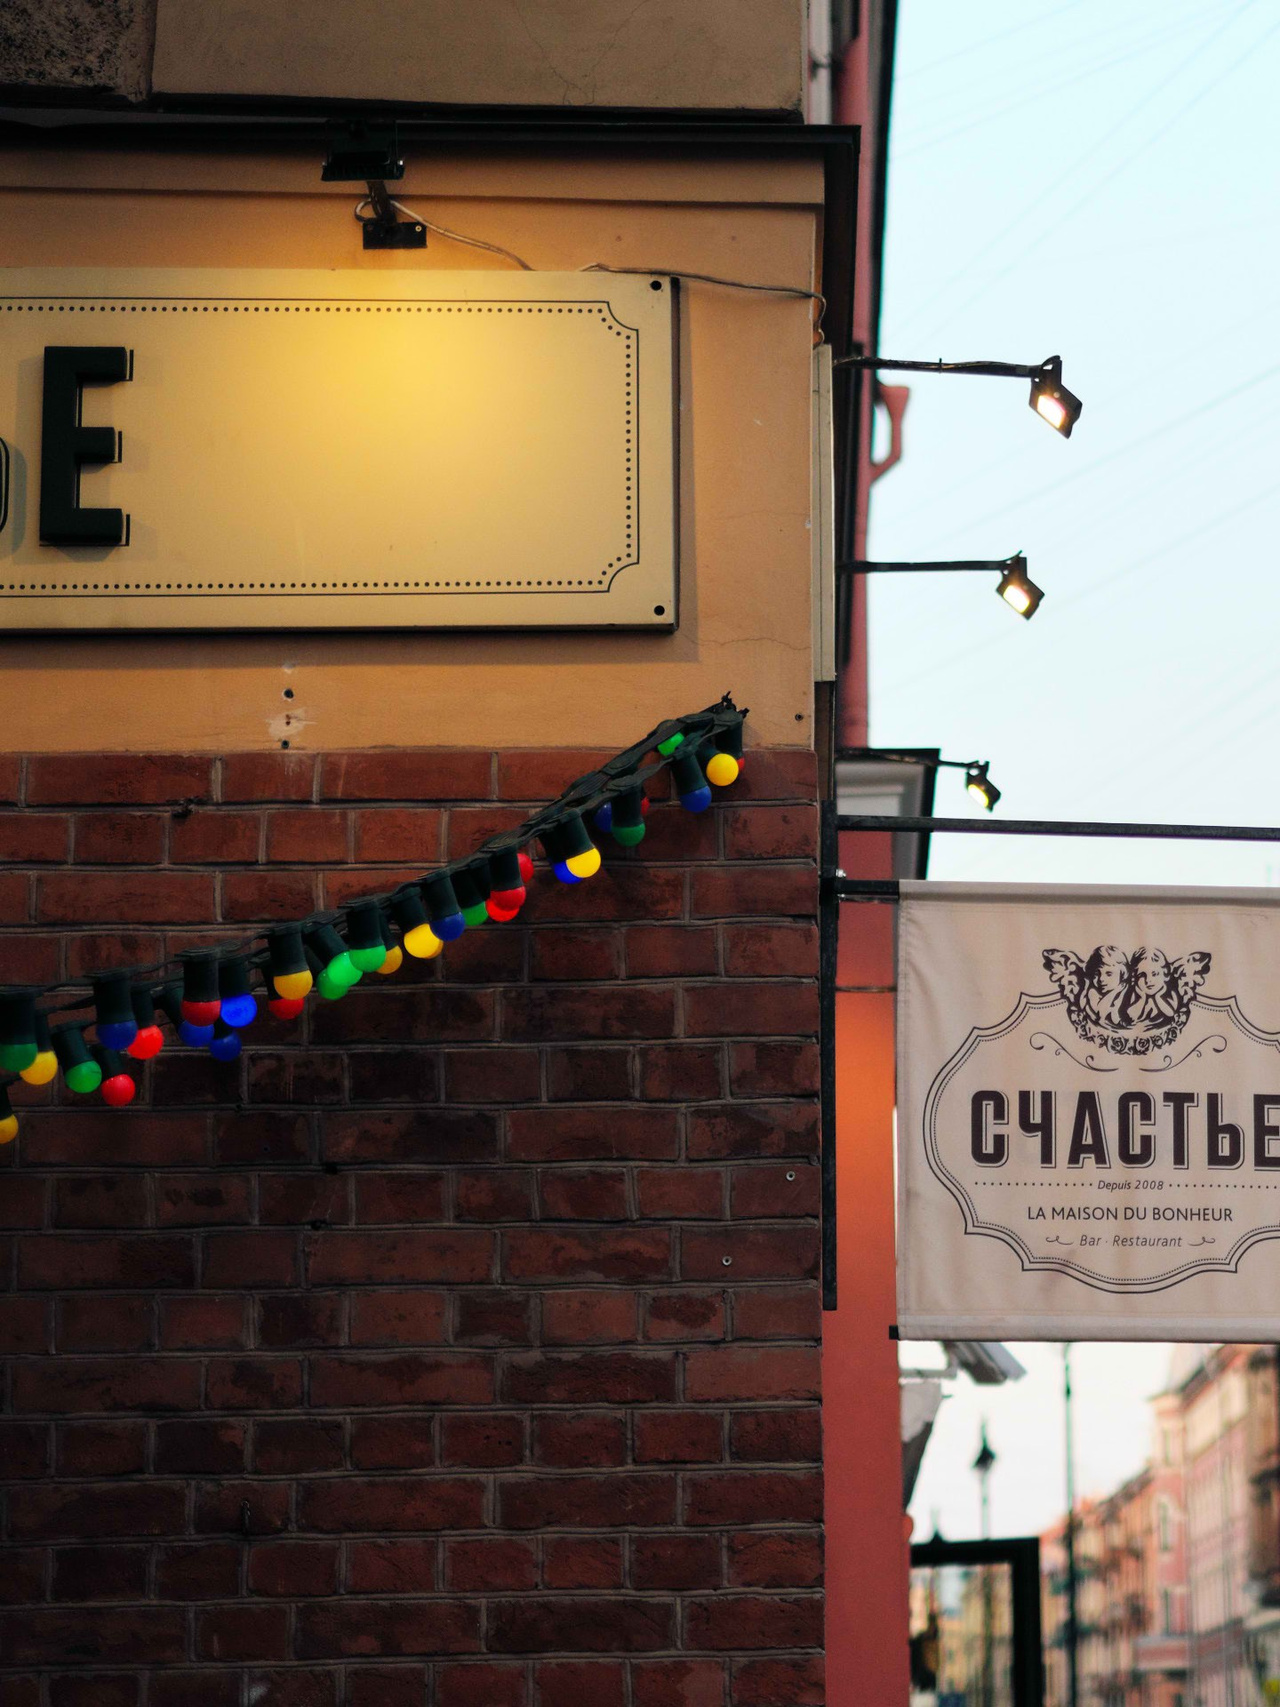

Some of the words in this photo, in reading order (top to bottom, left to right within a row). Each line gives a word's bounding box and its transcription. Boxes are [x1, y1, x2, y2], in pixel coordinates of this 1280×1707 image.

[1097, 1180, 1132, 1193] Depuis
[1134, 1180, 1164, 1191] 2008
[1027, 1206, 1047, 1221] LA
[1051, 1206, 1118, 1221] MAISON
[1123, 1206, 1147, 1222] DU
[1152, 1207, 1233, 1222] BONHEUR
[1079, 1234, 1102, 1247] Bar
[1112, 1234, 1183, 1248] Restaurant
